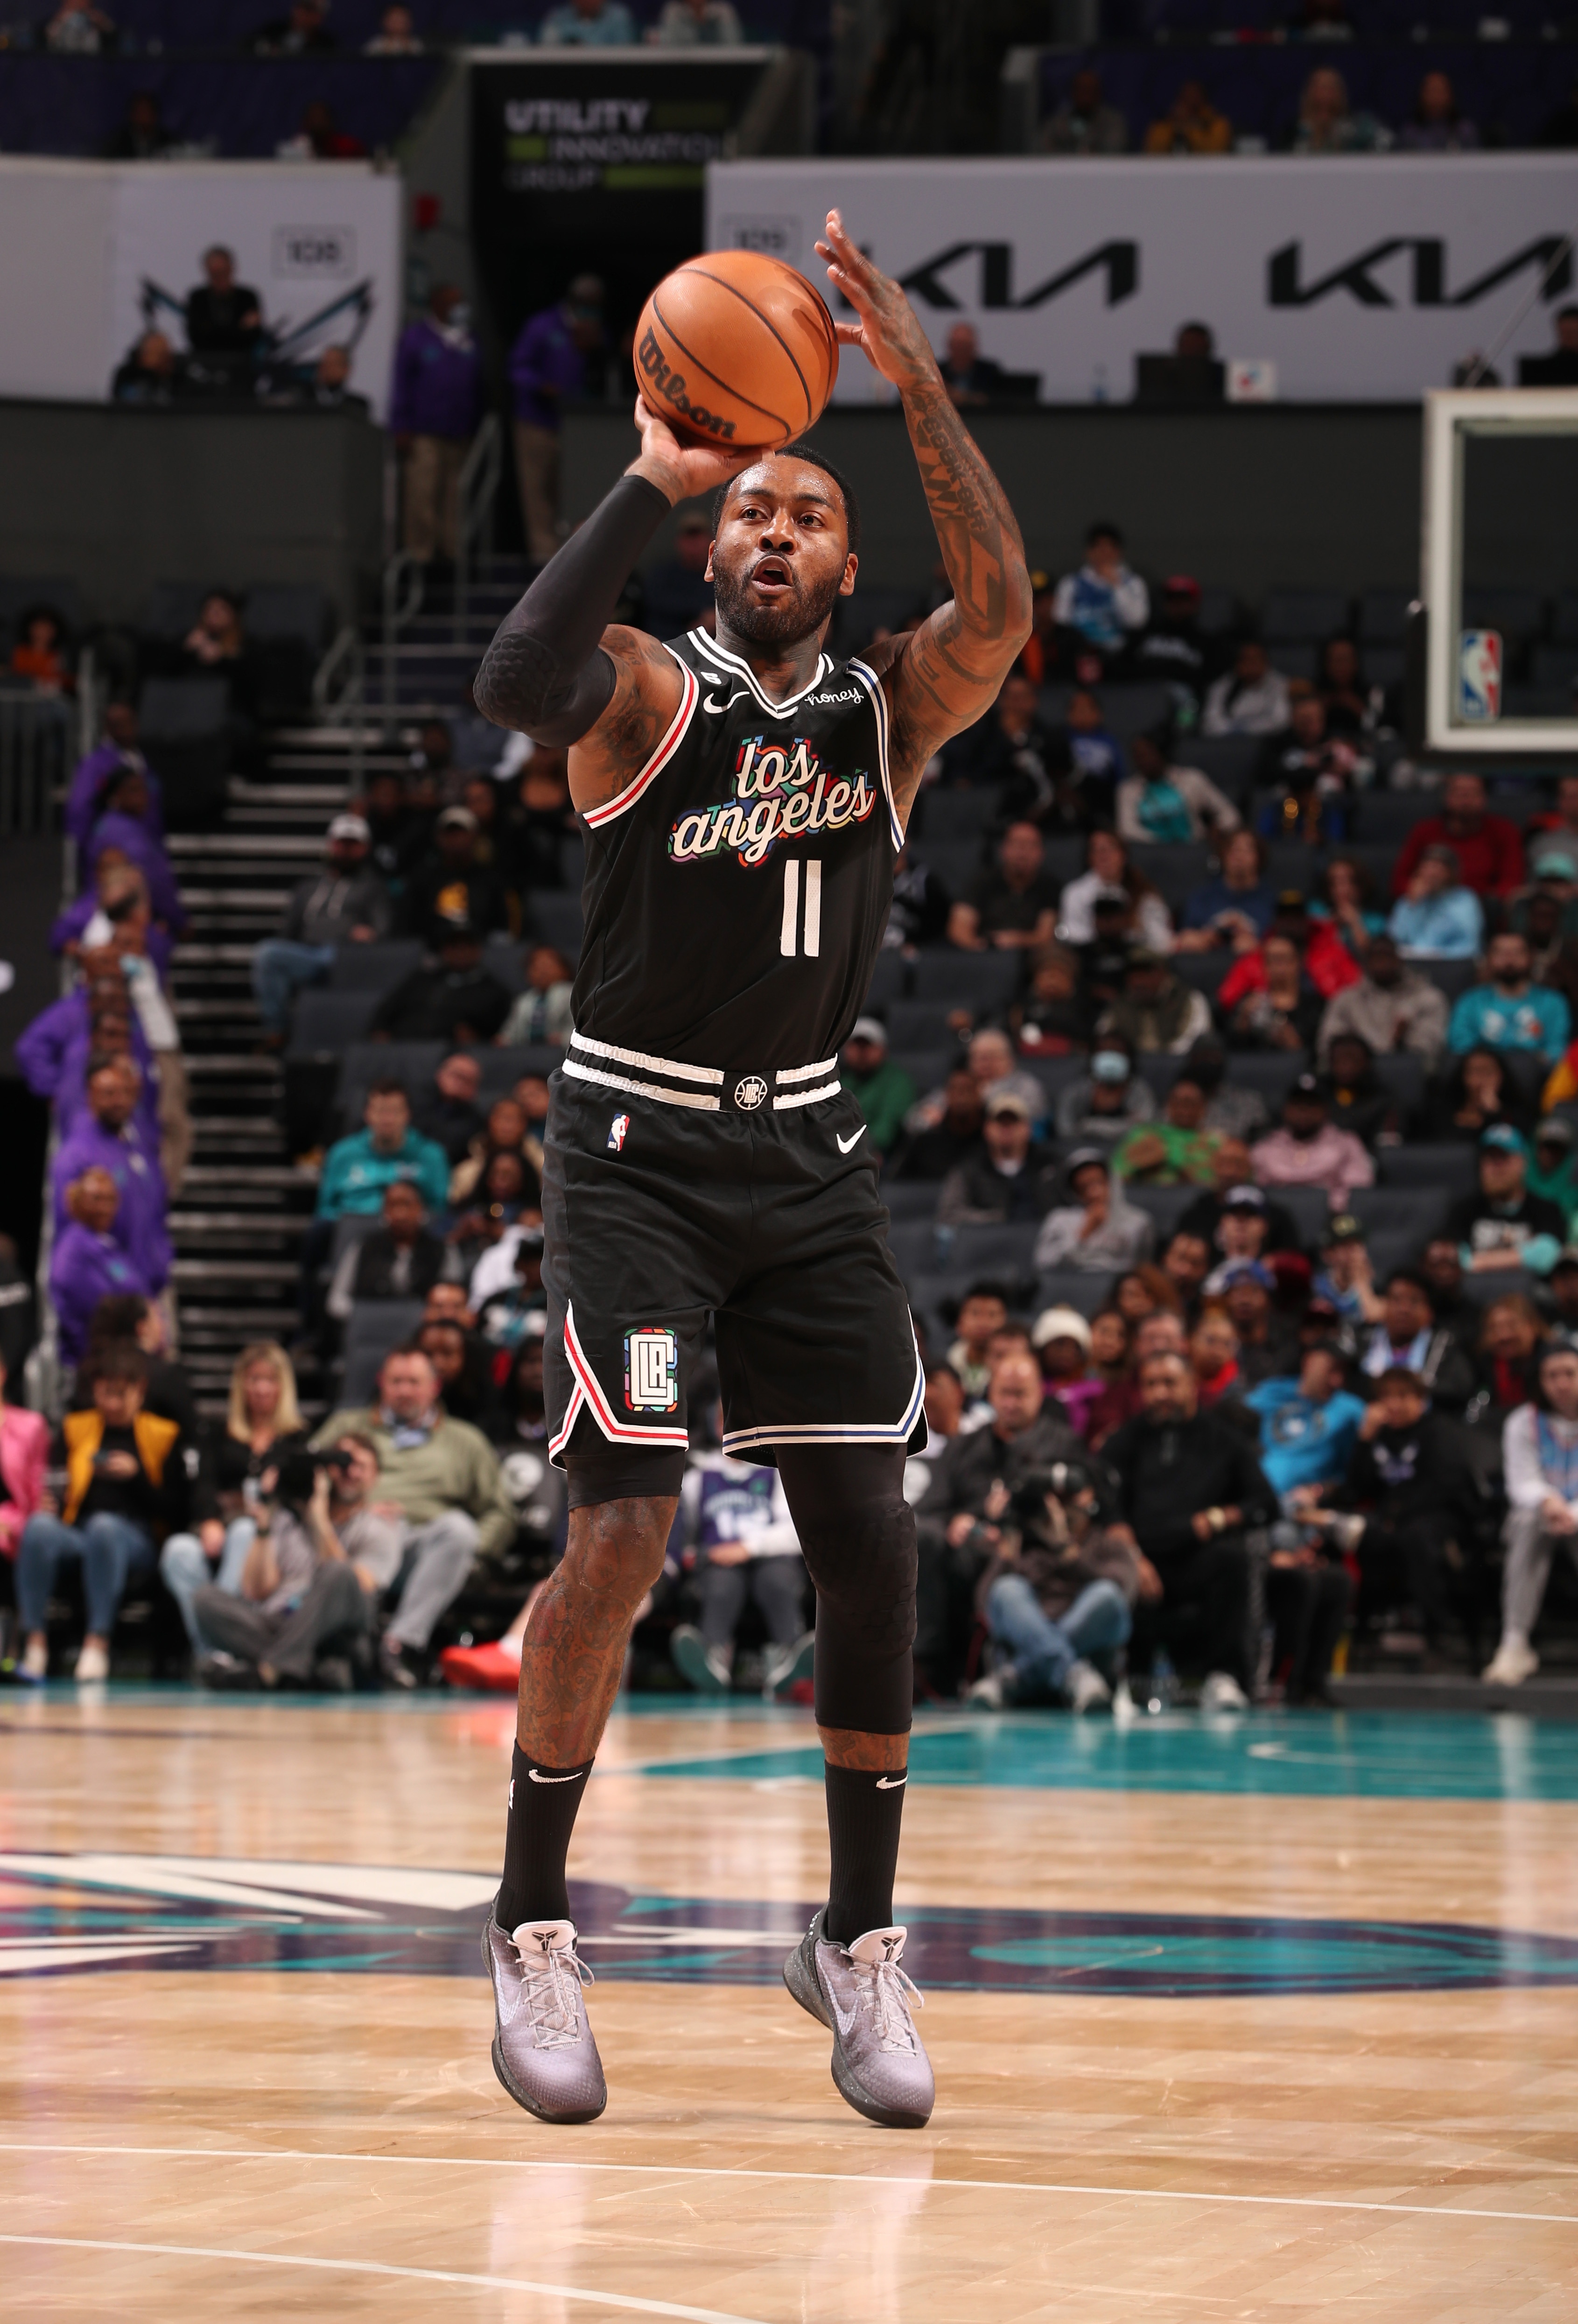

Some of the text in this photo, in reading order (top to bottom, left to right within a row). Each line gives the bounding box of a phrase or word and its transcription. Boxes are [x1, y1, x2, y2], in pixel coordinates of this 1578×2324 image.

[505, 99, 651, 132] UTILITY
[838, 240, 1138, 310] KIA
[1269, 238, 1572, 308] KIA
[638, 326, 737, 438] Wilson
[805, 688, 864, 706] honey
[735, 742, 820, 799] los
[672, 773, 875, 863] angeles
[780, 859, 822, 957] 11
[608, 1141, 617, 1149] NBA
